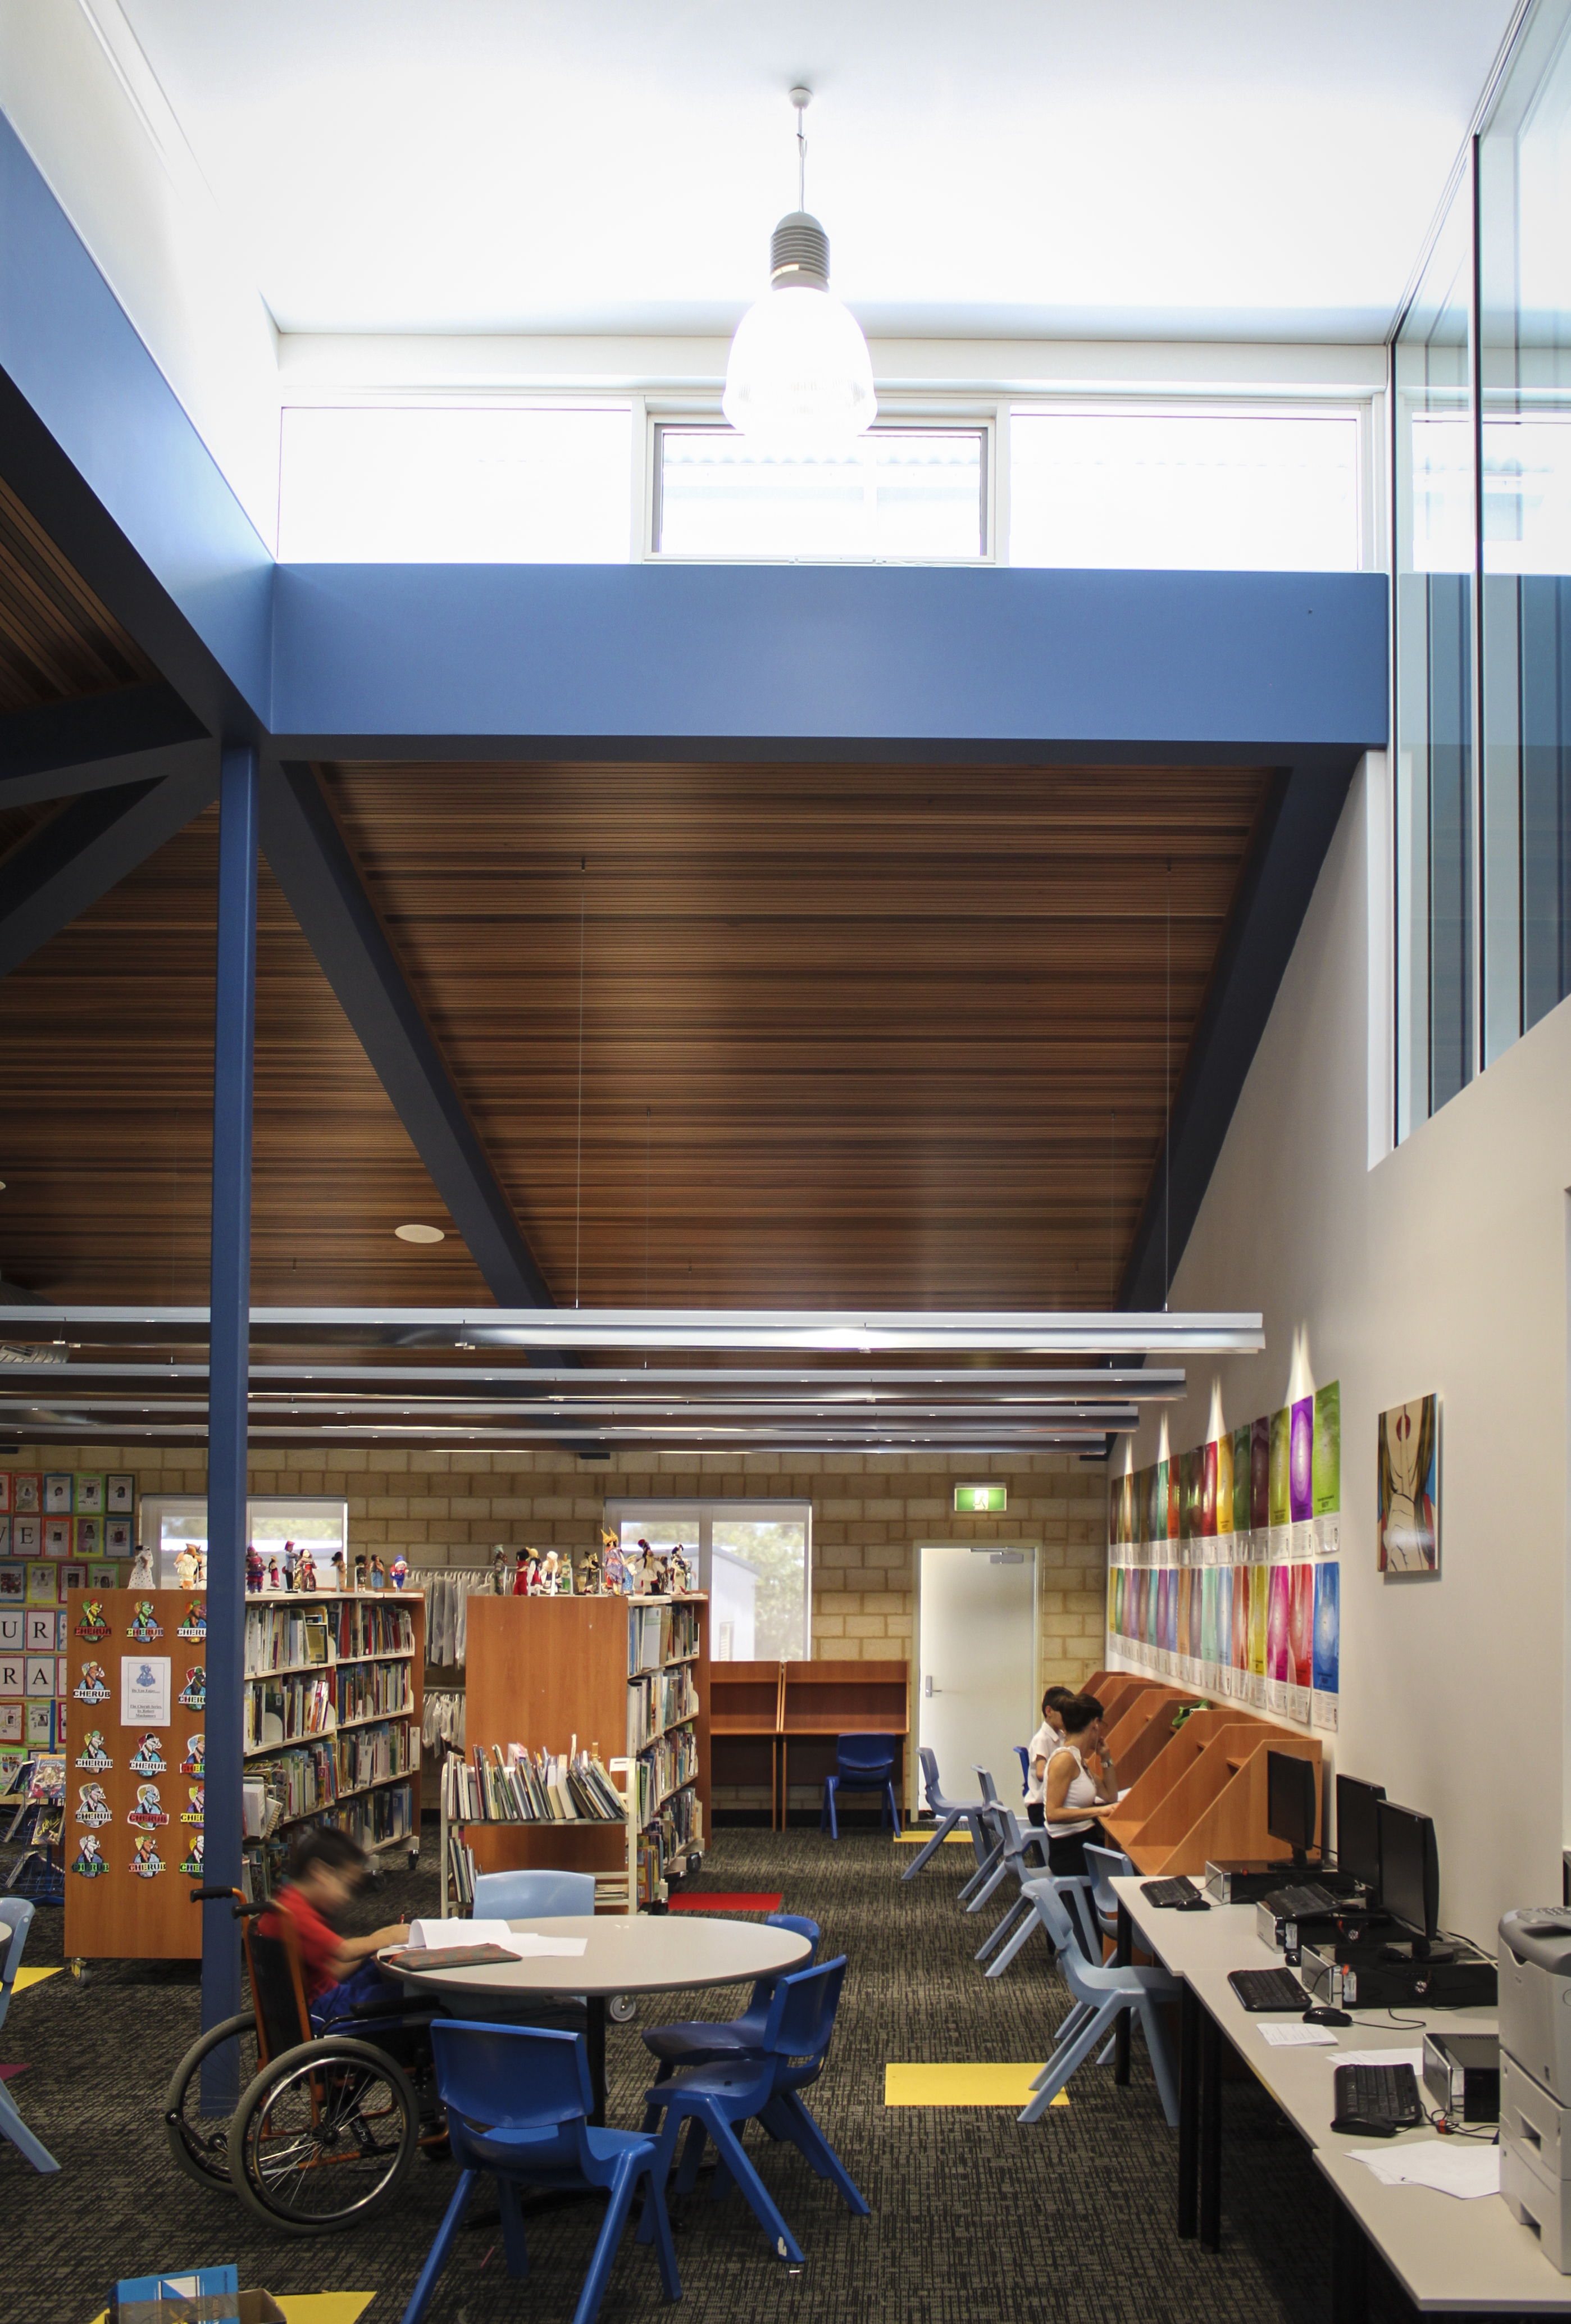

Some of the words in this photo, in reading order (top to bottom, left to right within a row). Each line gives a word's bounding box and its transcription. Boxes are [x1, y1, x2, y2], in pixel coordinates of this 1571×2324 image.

[129, 1814, 167, 1822] CHERUB
[72, 1863, 109, 1871] CHERUB
[129, 1862, 166, 1871] CHERUB
